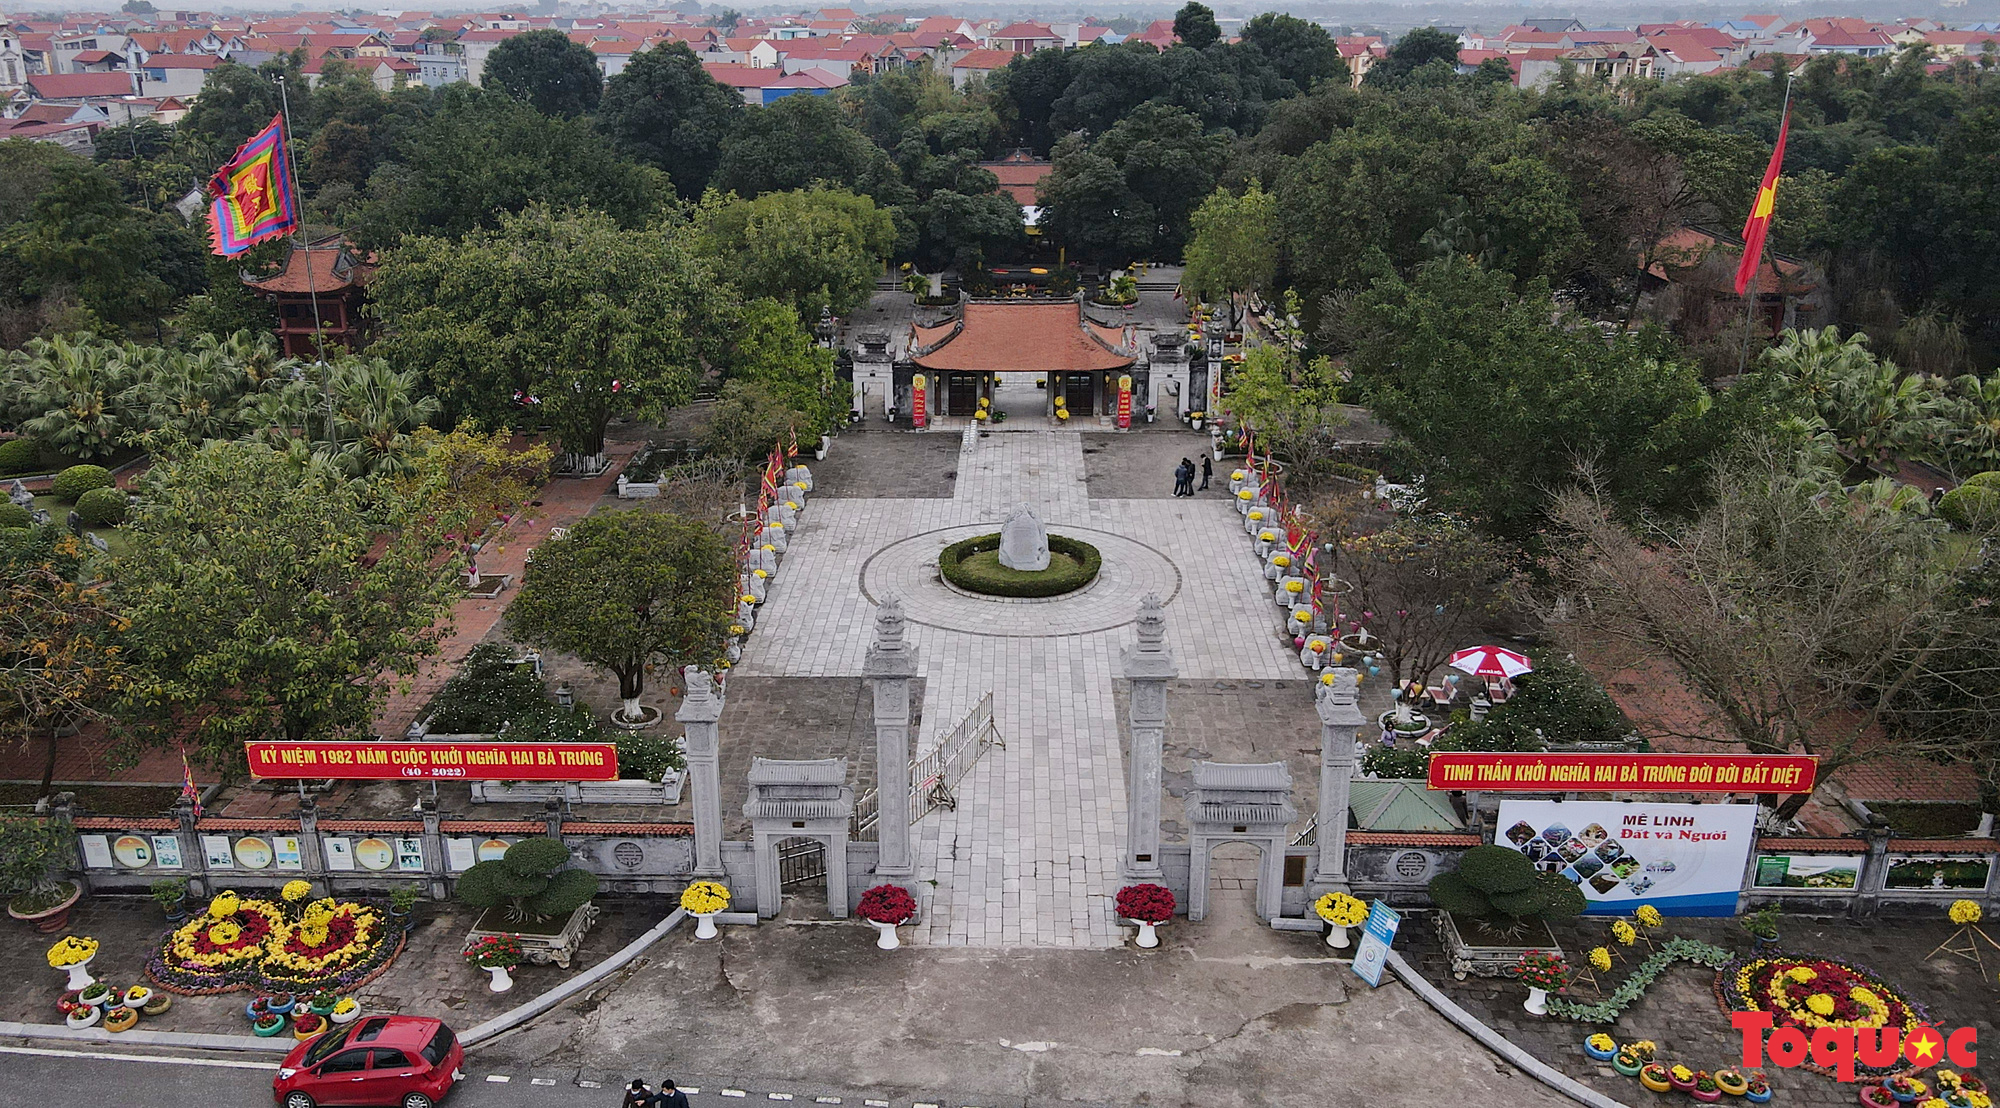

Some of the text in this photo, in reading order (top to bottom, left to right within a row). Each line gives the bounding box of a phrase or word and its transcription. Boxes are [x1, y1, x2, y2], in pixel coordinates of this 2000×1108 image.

[260, 745, 604, 767] KỶ NIỆM 1982 NĂM CUỘC KHỞI NGHĨA HAI BÀ TRƯNG
[431, 767, 466, 777] 2022)
[1443, 759, 1802, 788] TINH THẦN KHỞI NGHĨA HAI BÀ TRƯNG ĐỜI ĐỜI BẤT DIỆT
[1623, 813, 1695, 827] MÊ LINH
[1620, 828, 1728, 842] Đất và Người
